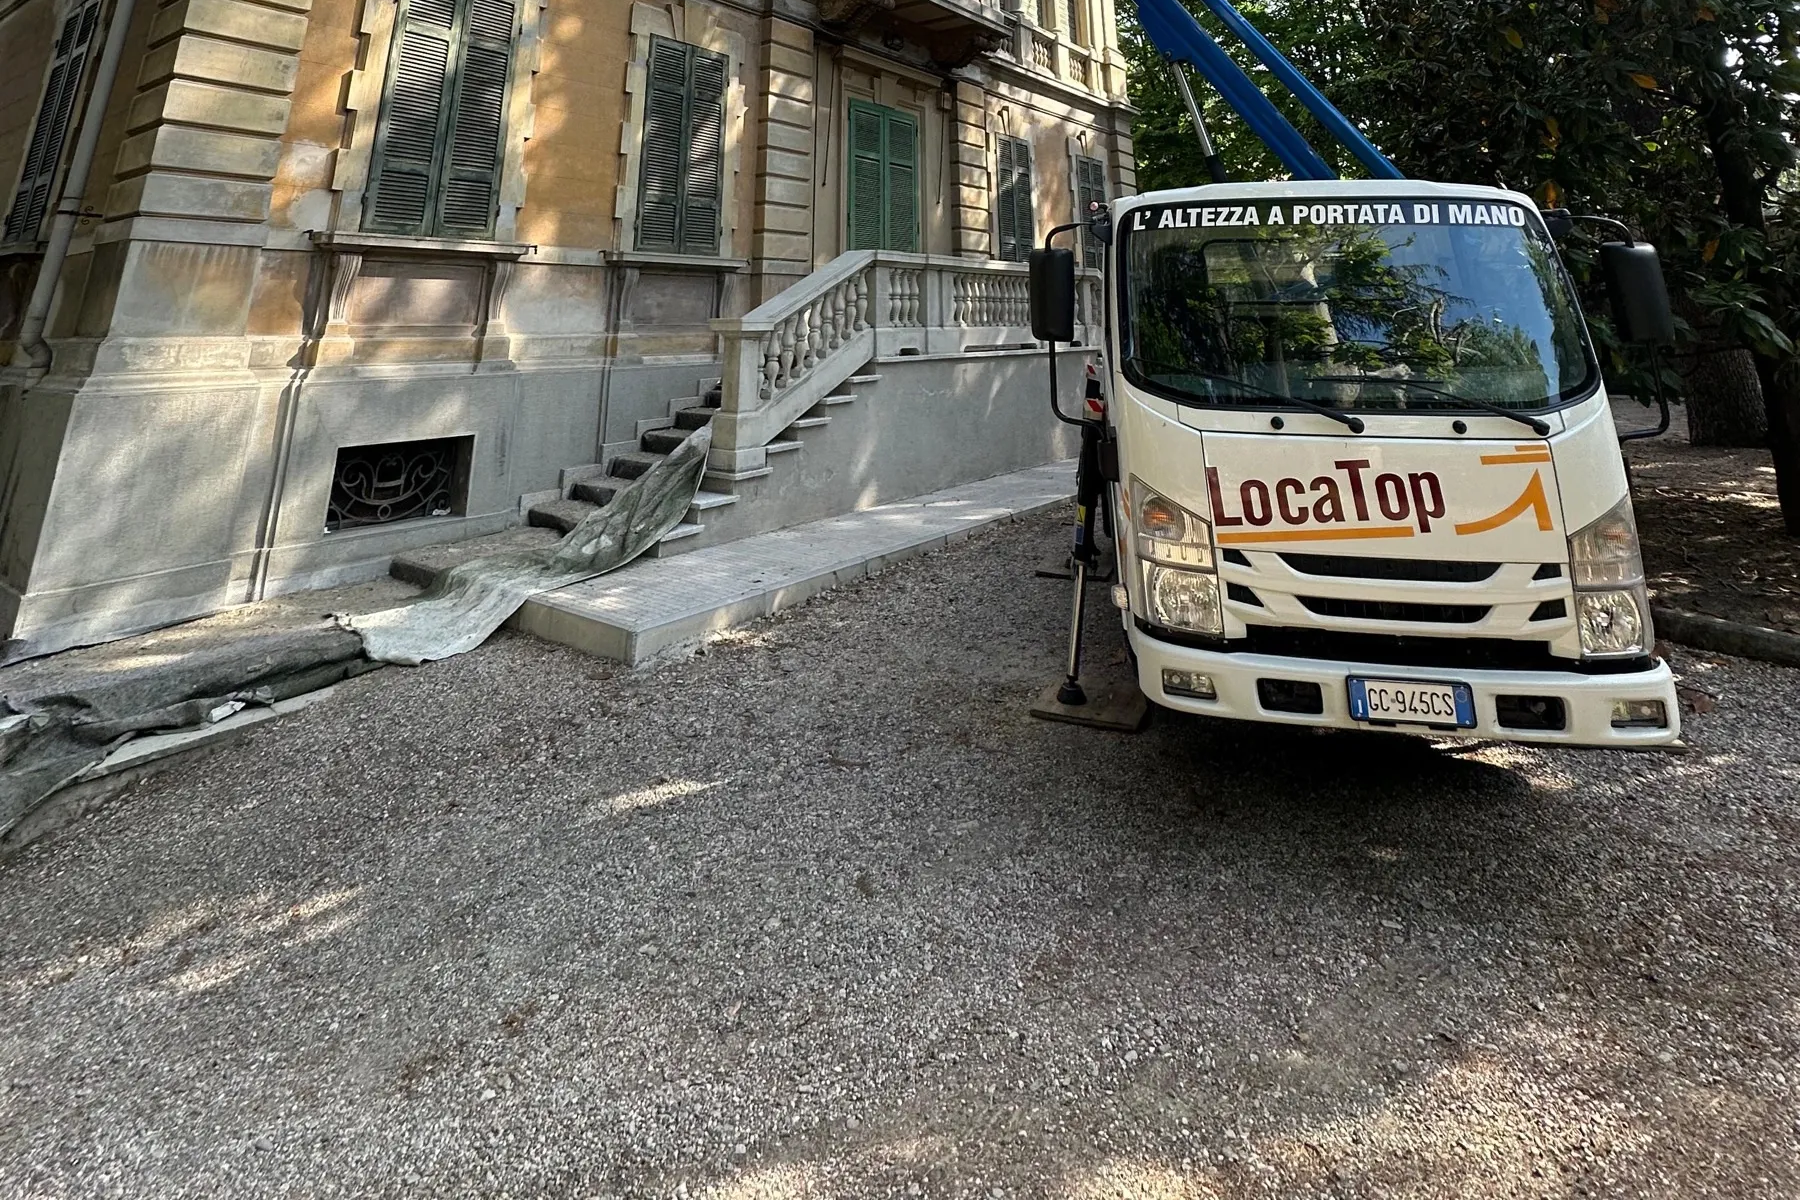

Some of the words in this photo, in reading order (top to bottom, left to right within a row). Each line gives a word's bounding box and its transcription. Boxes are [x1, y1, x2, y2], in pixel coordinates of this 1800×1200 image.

[1158, 206, 1260, 229] ALTEZZA
[1267, 205, 1285, 226] A
[1293, 203, 1406, 225] PORTATA
[1413, 204, 1440, 224] DI
[1448, 204, 1526, 227] MANO
[1206, 459, 1446, 534] LocaTop
